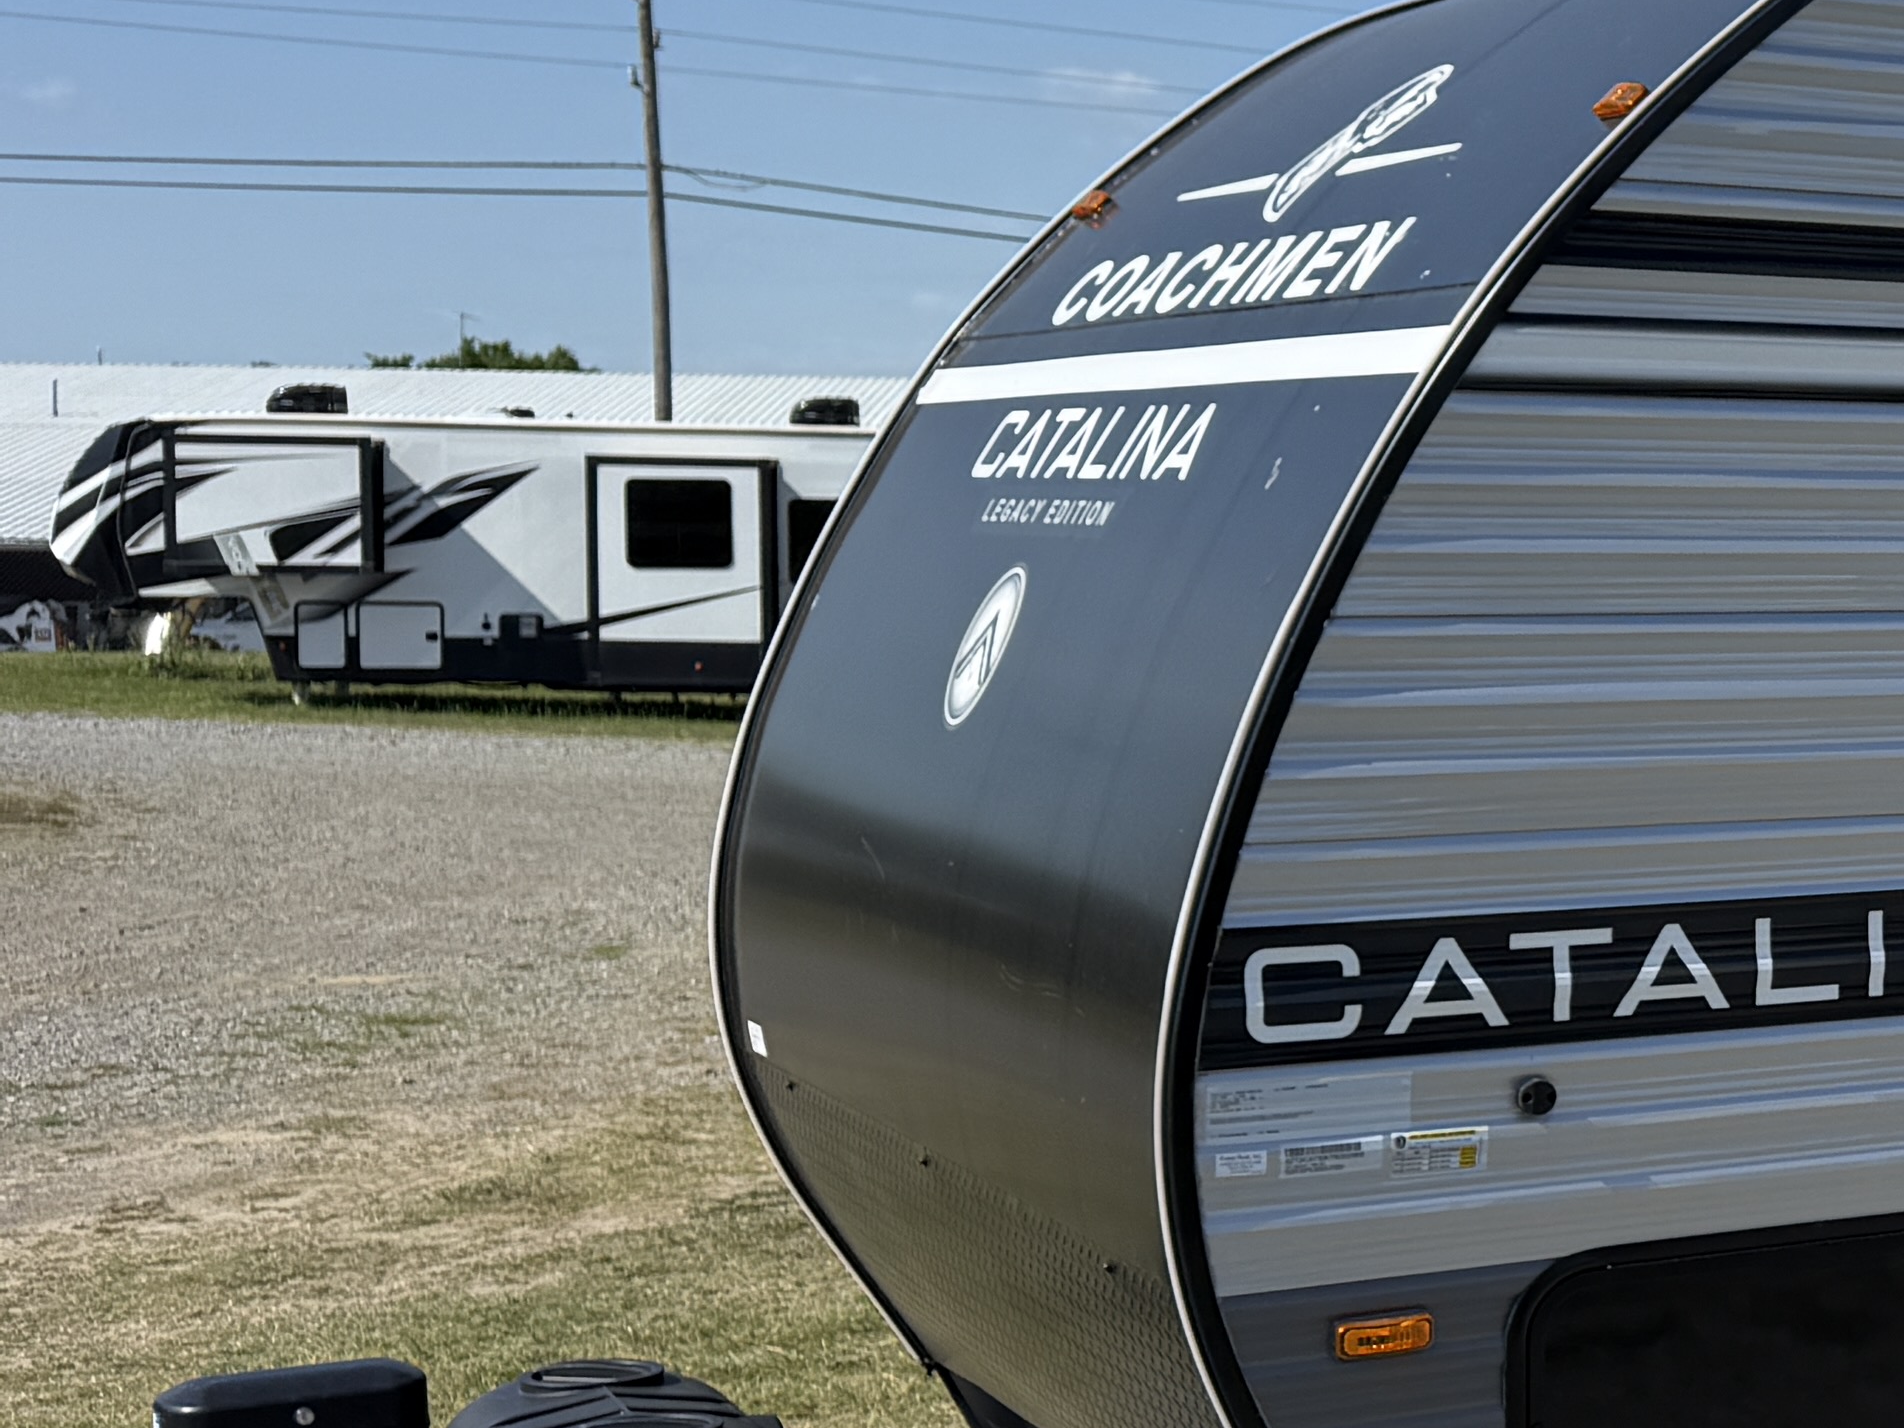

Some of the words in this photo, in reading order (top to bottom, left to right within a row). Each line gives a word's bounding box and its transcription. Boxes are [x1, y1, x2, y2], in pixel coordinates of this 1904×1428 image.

[1051, 216, 1417, 326] COACHMEN
[971, 403, 1217, 481] CATALINA
[981, 498, 1047, 523] LEGACY
[1043, 499, 1115, 526] EDITION
